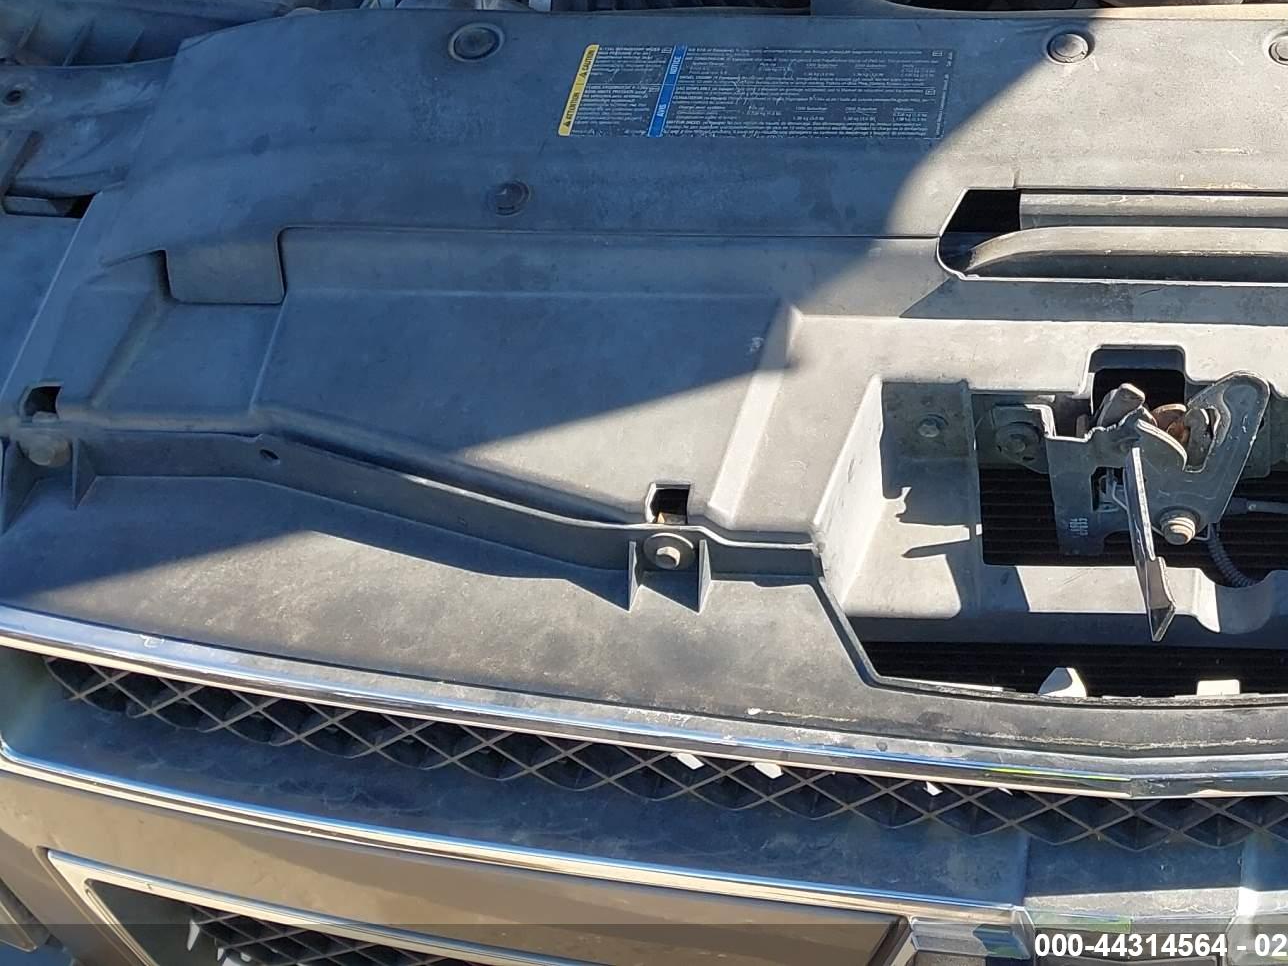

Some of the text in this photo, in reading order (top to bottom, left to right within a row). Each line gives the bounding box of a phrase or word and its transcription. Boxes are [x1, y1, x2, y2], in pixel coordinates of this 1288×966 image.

[580, 49, 595, 72] CAUTION
[669, 55, 682, 75] NOTICE
[566, 92, 580, 121] ATTENTION
[656, 103, 667, 117] AVIS
